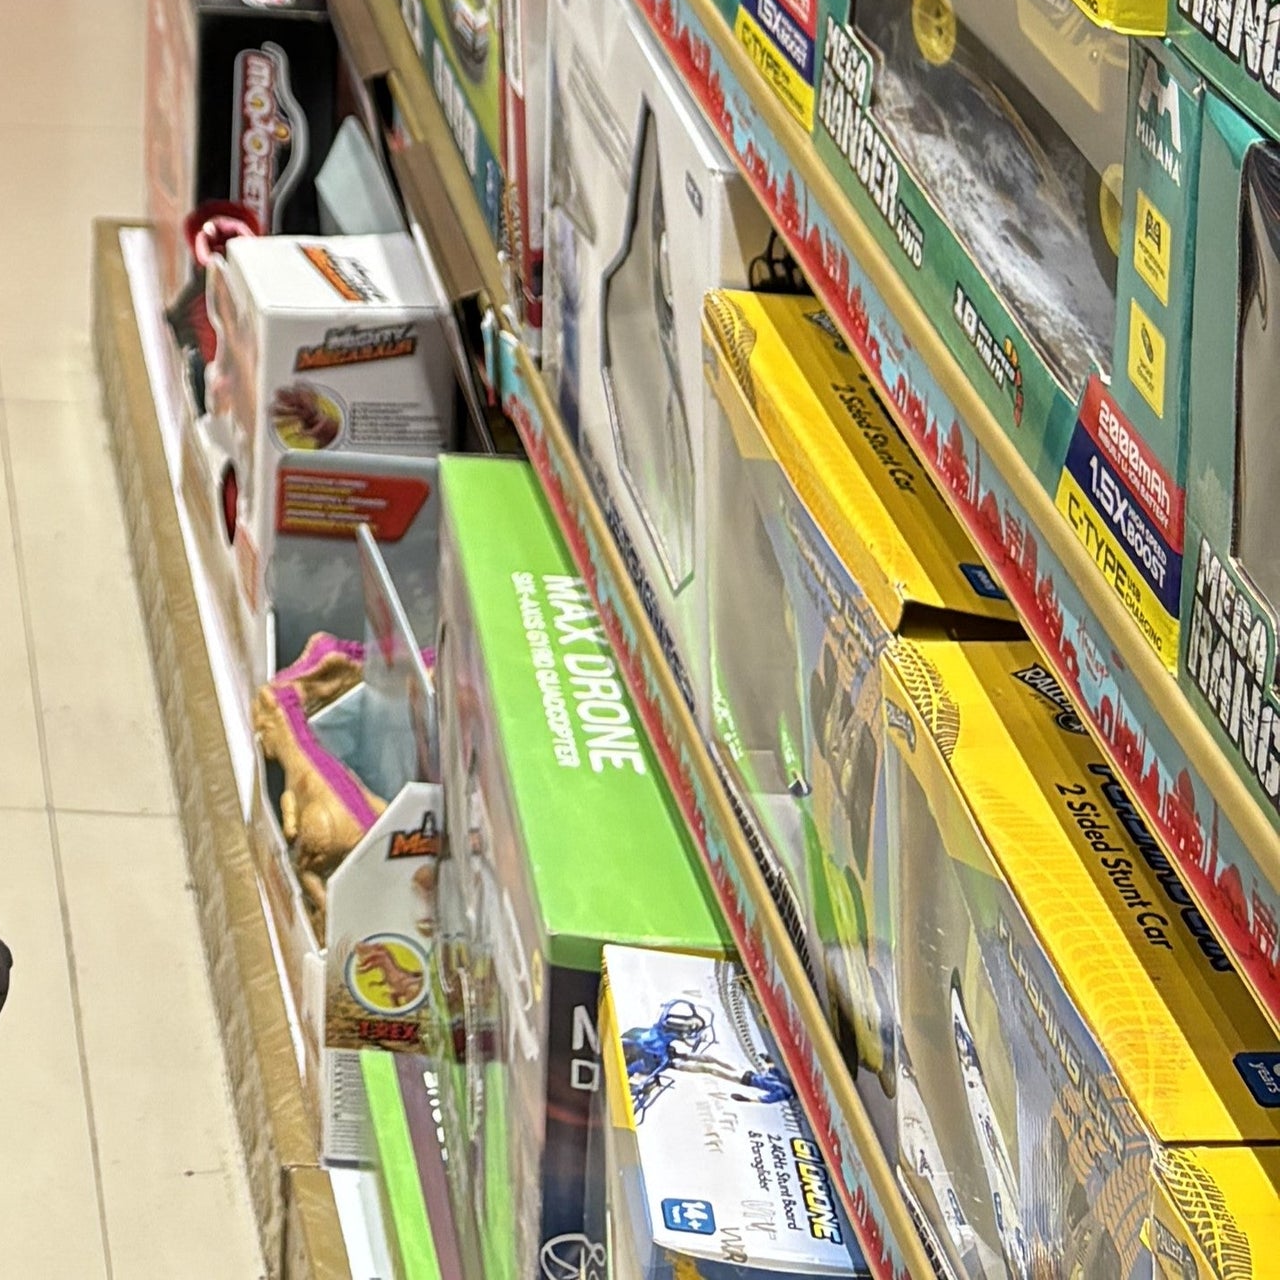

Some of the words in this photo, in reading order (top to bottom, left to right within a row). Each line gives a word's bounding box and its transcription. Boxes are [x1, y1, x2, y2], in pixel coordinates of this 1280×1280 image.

[826, 15, 869, 109] MEGA
[819, 61, 900, 230] RANGER
[895, 217, 923, 270] 4WD
[1135, 111, 1183, 188] MIRANA
[889, 464, 916, 495] Car
[1099, 399, 1172, 516] 2000mAh
[1067, 492, 1127, 597] C-TYPE
[1089, 454, 1129, 536] 1.5X
[1144, 523, 1168, 565] SPEED
[1126, 523, 1166, 588] BOOST
[543, 574, 604, 647] MAX
[1124, 592, 1163, 652] CHARGING
[1196, 538, 1268, 688] MEGA
[563, 653, 647, 775] DRONE
[1055, 782, 1085, 797] 2
[1067, 799, 1115, 853] Sided
[1101, 847, 1147, 909] Stunt
[1137, 911, 1172, 950] Car
